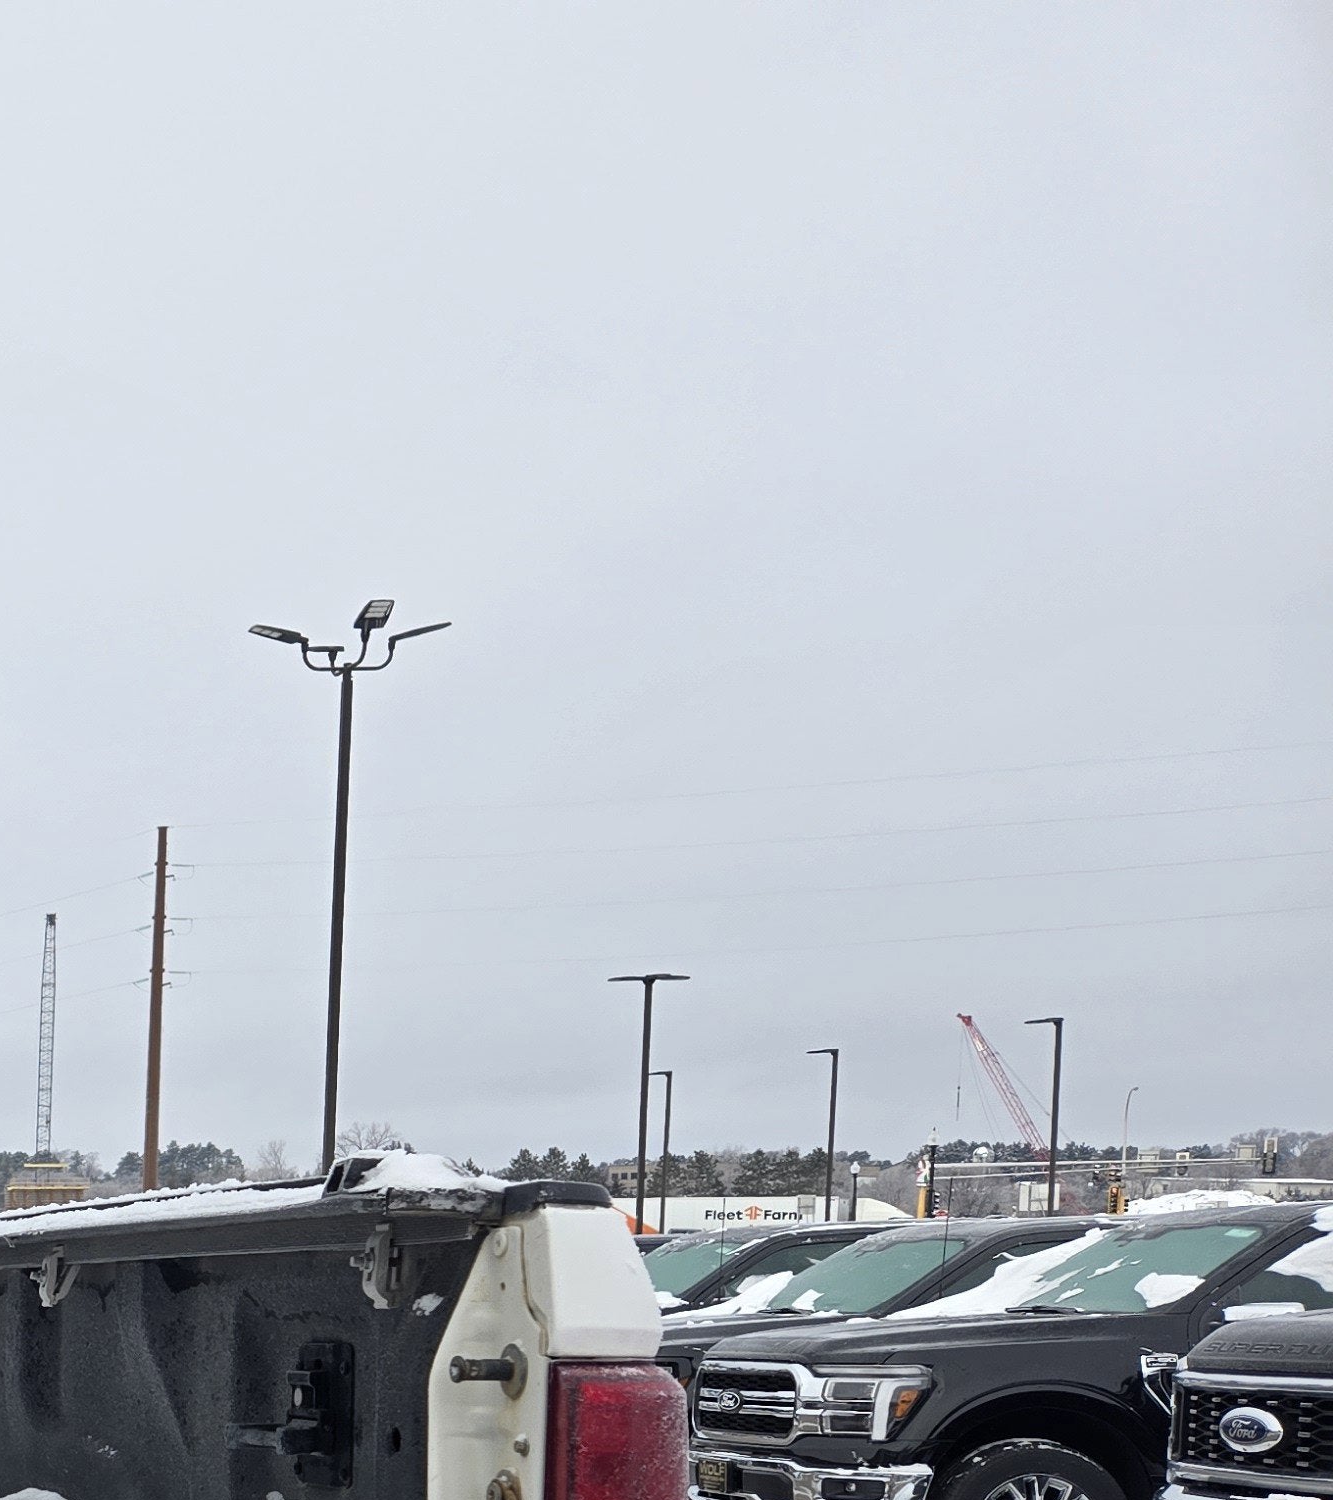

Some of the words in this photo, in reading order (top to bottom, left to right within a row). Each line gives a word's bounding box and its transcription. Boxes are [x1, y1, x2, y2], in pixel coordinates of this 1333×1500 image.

[705, 1210, 743, 1221] Fleet
[1203, 1341, 1285, 1354] SUPER
[1228, 1419, 1259, 1439] Ford
[699, 1461, 726, 1476] WOLF
